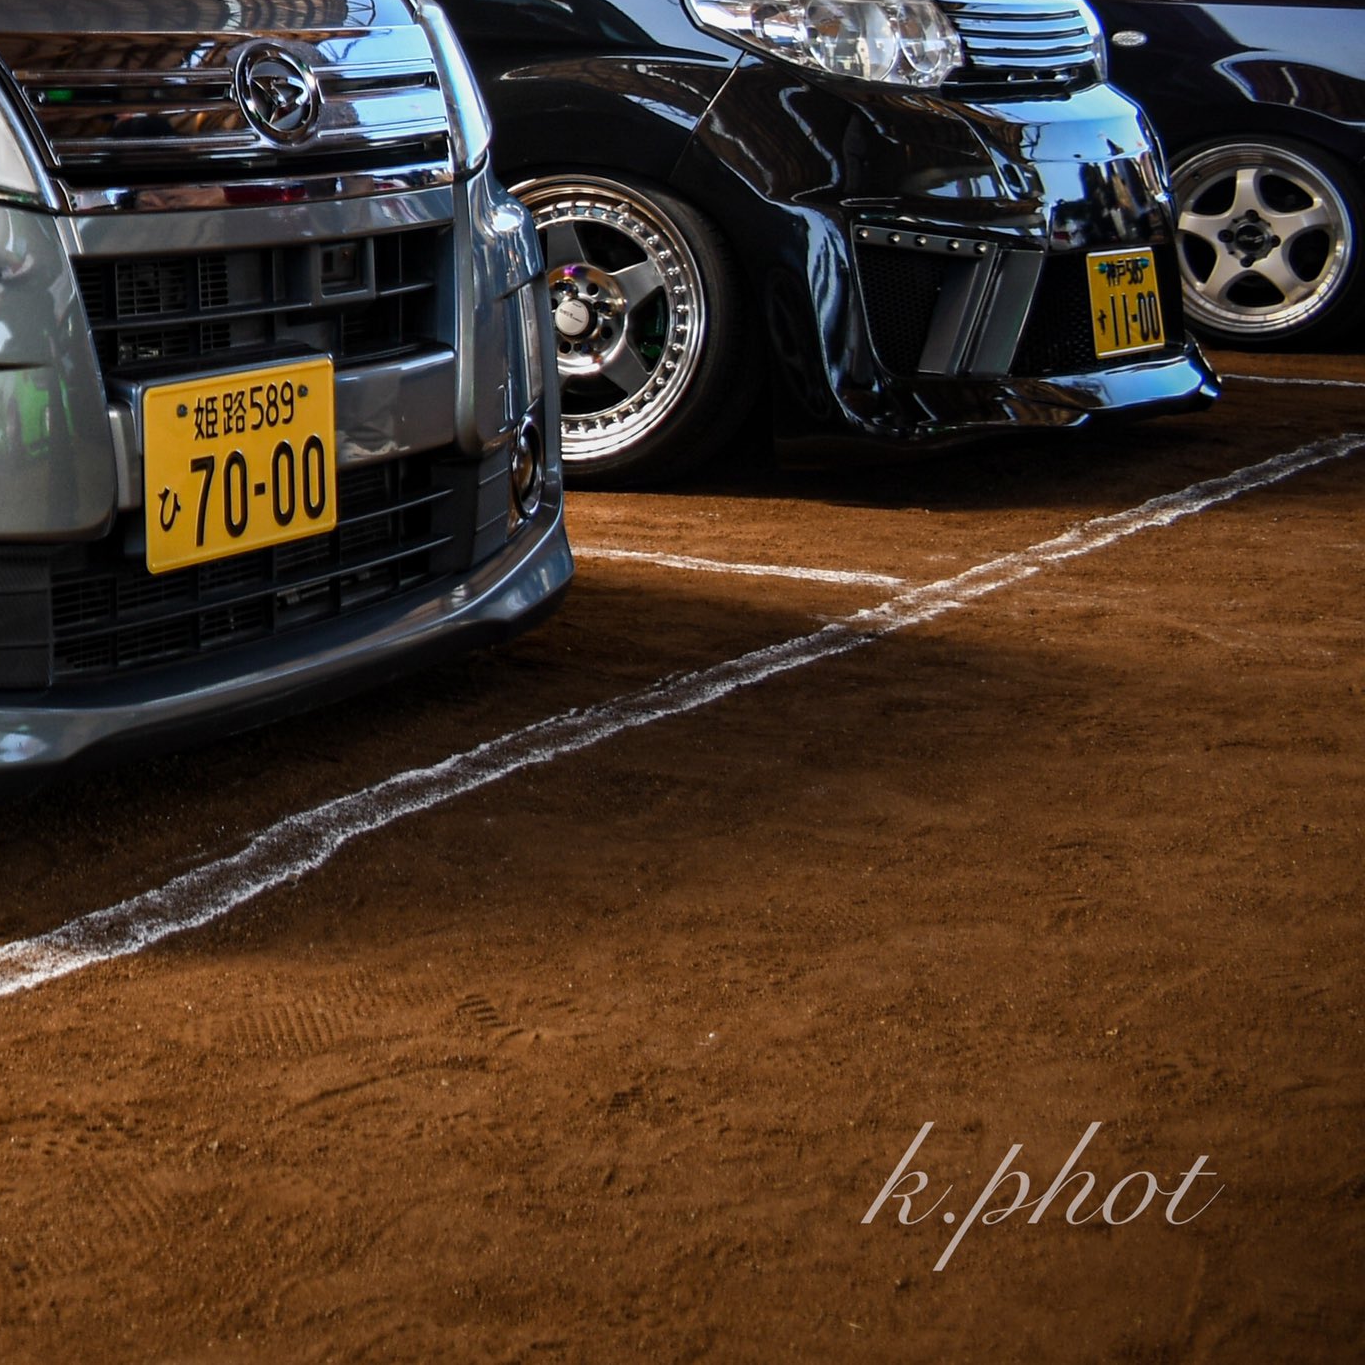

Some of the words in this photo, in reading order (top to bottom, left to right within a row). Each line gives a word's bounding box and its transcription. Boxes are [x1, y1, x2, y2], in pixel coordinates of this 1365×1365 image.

[1110, 290, 1161, 348] 11-00
[193, 379, 295, 441] 姫路589
[158, 486, 181, 531] ひ
[190, 433, 326, 547] 70-00
